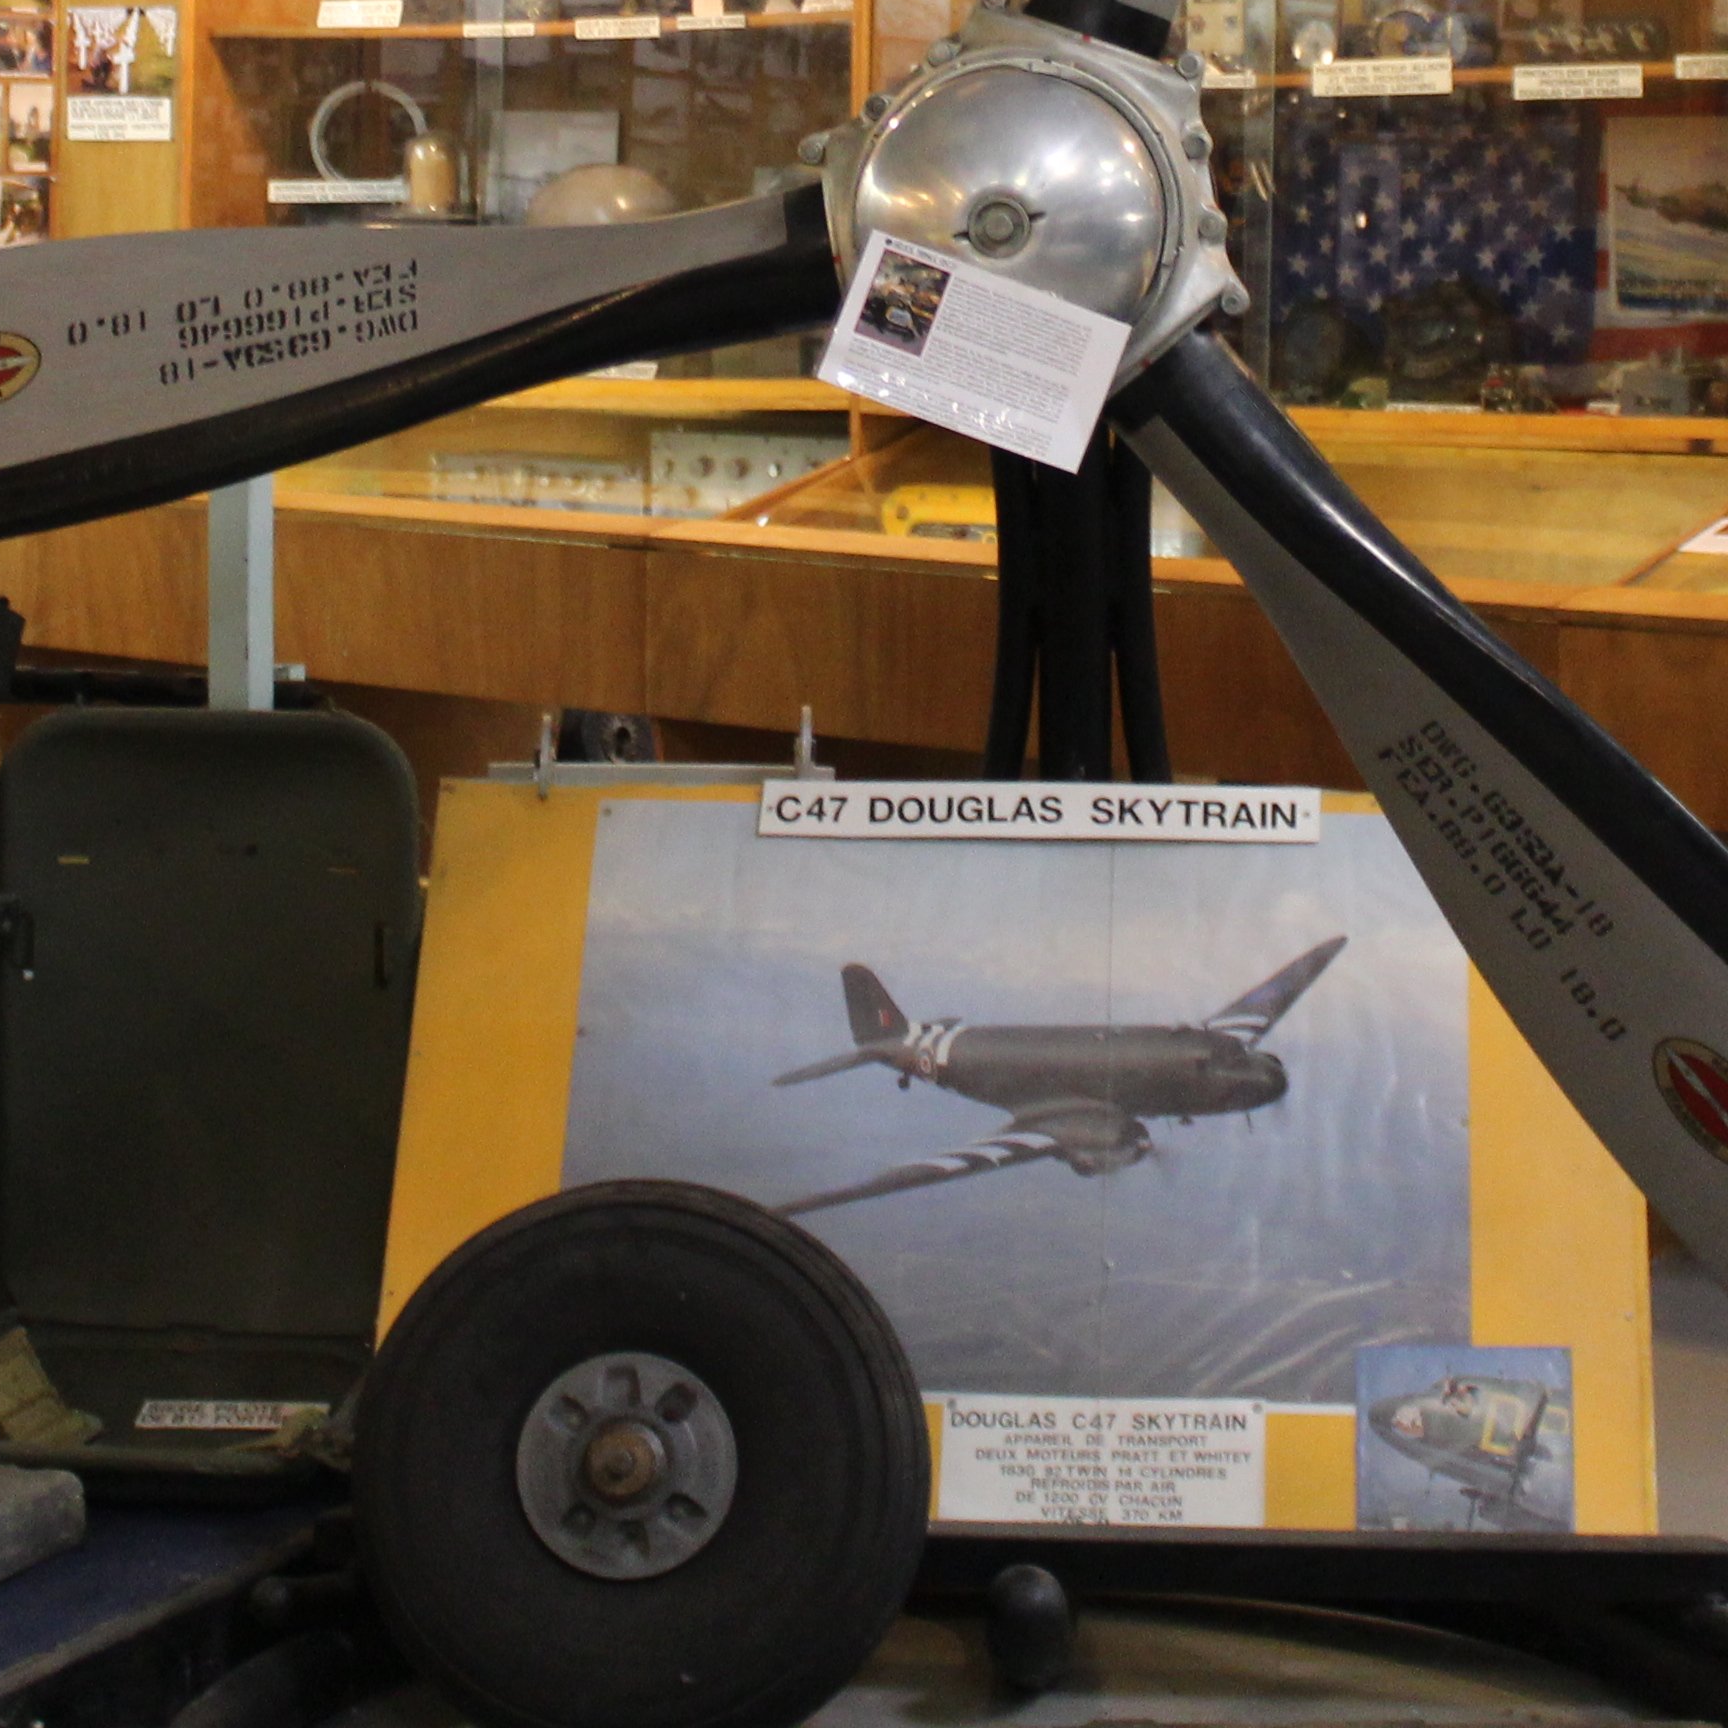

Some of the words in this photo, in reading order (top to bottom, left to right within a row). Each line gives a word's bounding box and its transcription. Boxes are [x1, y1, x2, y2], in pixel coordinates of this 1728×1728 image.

[776, 795, 848, 823] C47
[869, 795, 1064, 825] DOUGLAS
[1090, 797, 1298, 829] SKYTRAIN
[950, 1410, 1057, 1429] DOUGLAS
[1071, 1413, 1117, 1431] C47
[1132, 1413, 1248, 1432] SKYTRAIN
[1005, 1435, 1073, 1447] APPAREIL
[1086, 1435, 1105, 1447] DE
[1117, 1435, 1208, 1448] TRANSPORT
[975, 1448, 1018, 1462] DEUX
[1026, 1449, 1102, 1462] MOTEURS
[1111, 1450, 1160, 1463] PRATT
[1171, 1451, 1187, 1463] ET
[1140, 1467, 1228, 1480] CYLINDRES
[1115, 1480, 1144, 1493] PAR
[1150, 1481, 1177, 1493] AIR
[1015, 1491, 1036, 1504] DE
[1117, 1494, 1184, 1508] CHACUN
